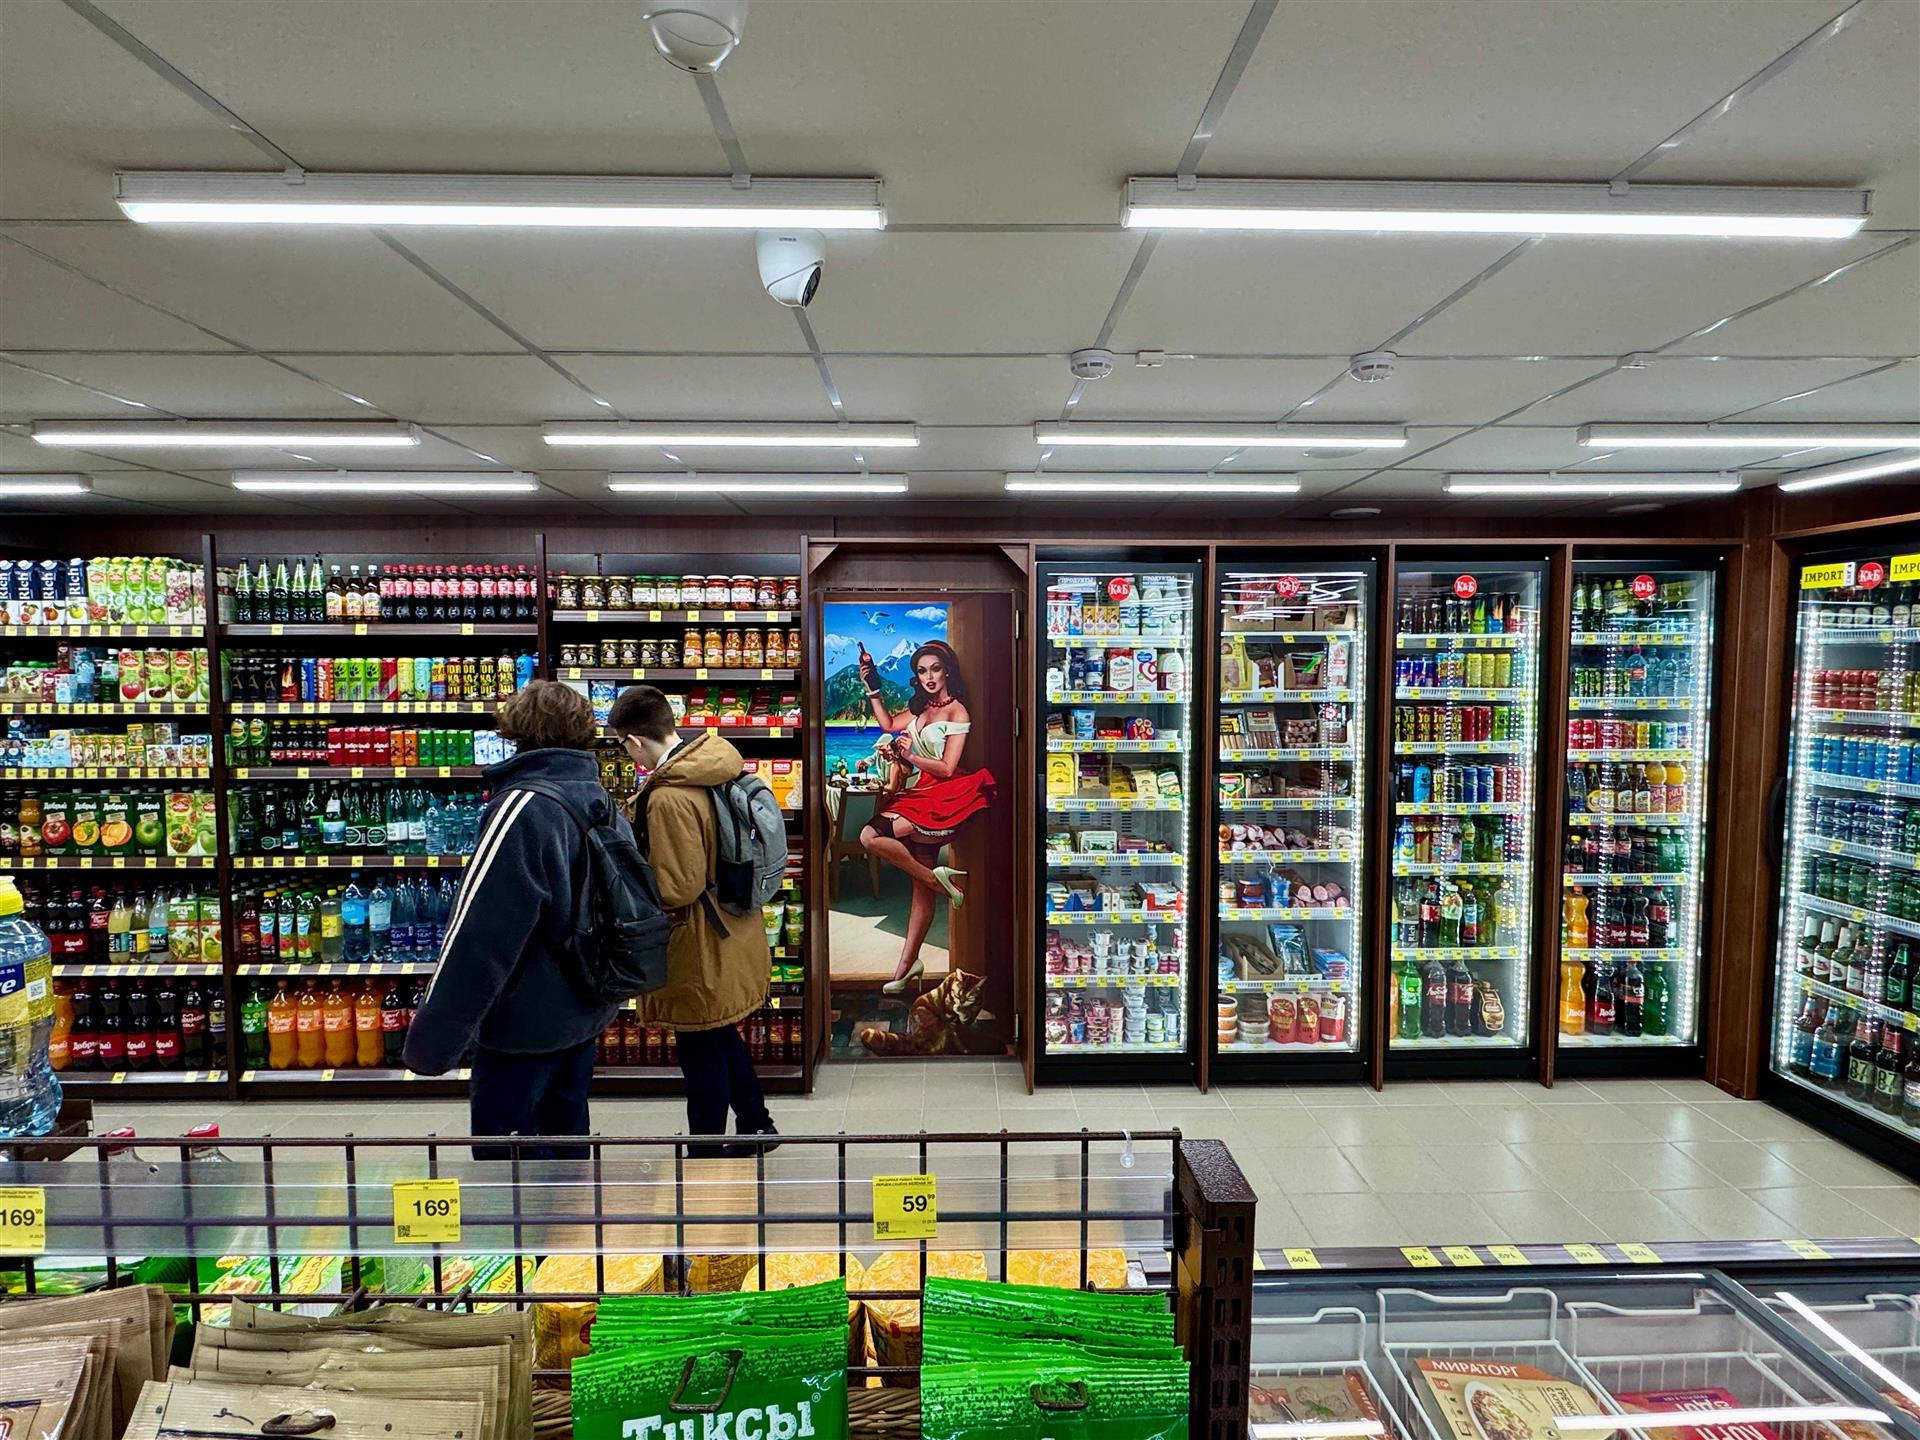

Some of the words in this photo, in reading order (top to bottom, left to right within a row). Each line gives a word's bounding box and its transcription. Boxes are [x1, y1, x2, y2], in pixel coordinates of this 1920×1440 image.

[18, 572, 30, 599] Rich
[41, 572, 54, 599] Rich
[68, 567, 80, 595] Rich
[1804, 570, 1844, 583] IMPORT
[1110, 585, 1128, 595] К&Б
[1904, 824, 1917, 848] EFES
[1408, 925, 1417, 942] Rich
[1850, 1059, 1867, 1081] 87
[1878, 1070, 1897, 1092] 87
[413, 1199, 450, 1216] 169
[903, 1195, 927, 1212] 59
[0, 1209, 35, 1226] 169
[1431, 1360, 1520, 1378] МИРАТОРГ
[622, 1401, 815, 1440] Тиксы
